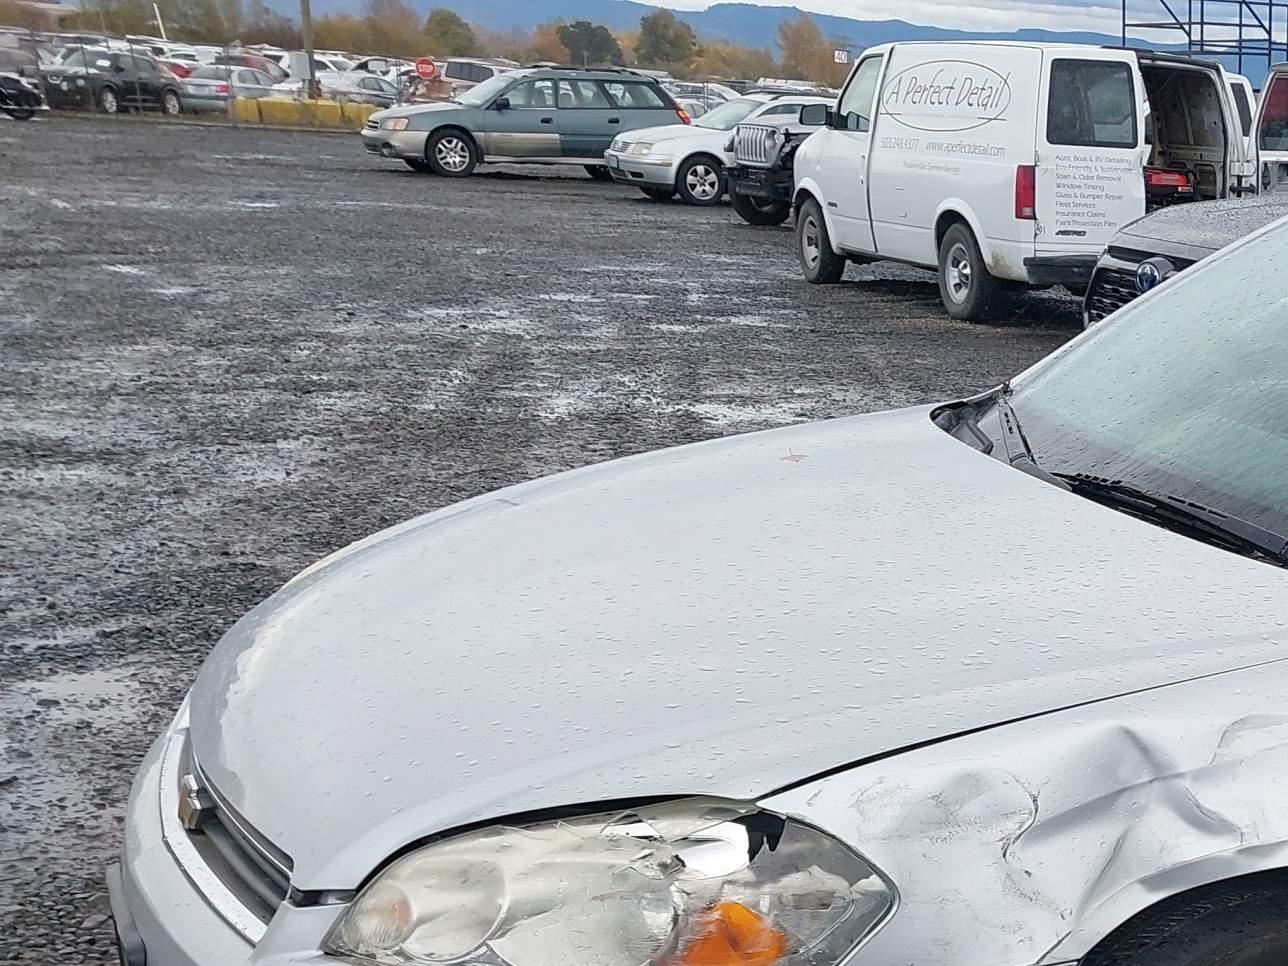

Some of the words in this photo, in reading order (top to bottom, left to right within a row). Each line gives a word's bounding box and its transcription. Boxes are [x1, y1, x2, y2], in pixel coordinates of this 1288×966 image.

[417, 64, 434, 73] STOP
[886, 76, 903, 105] A
[903, 69, 955, 106] Perfect
[955, 72, 1011, 111] Detail
[1072, 201, 1096, 209] Services
[1071, 219, 1103, 227] Protection
